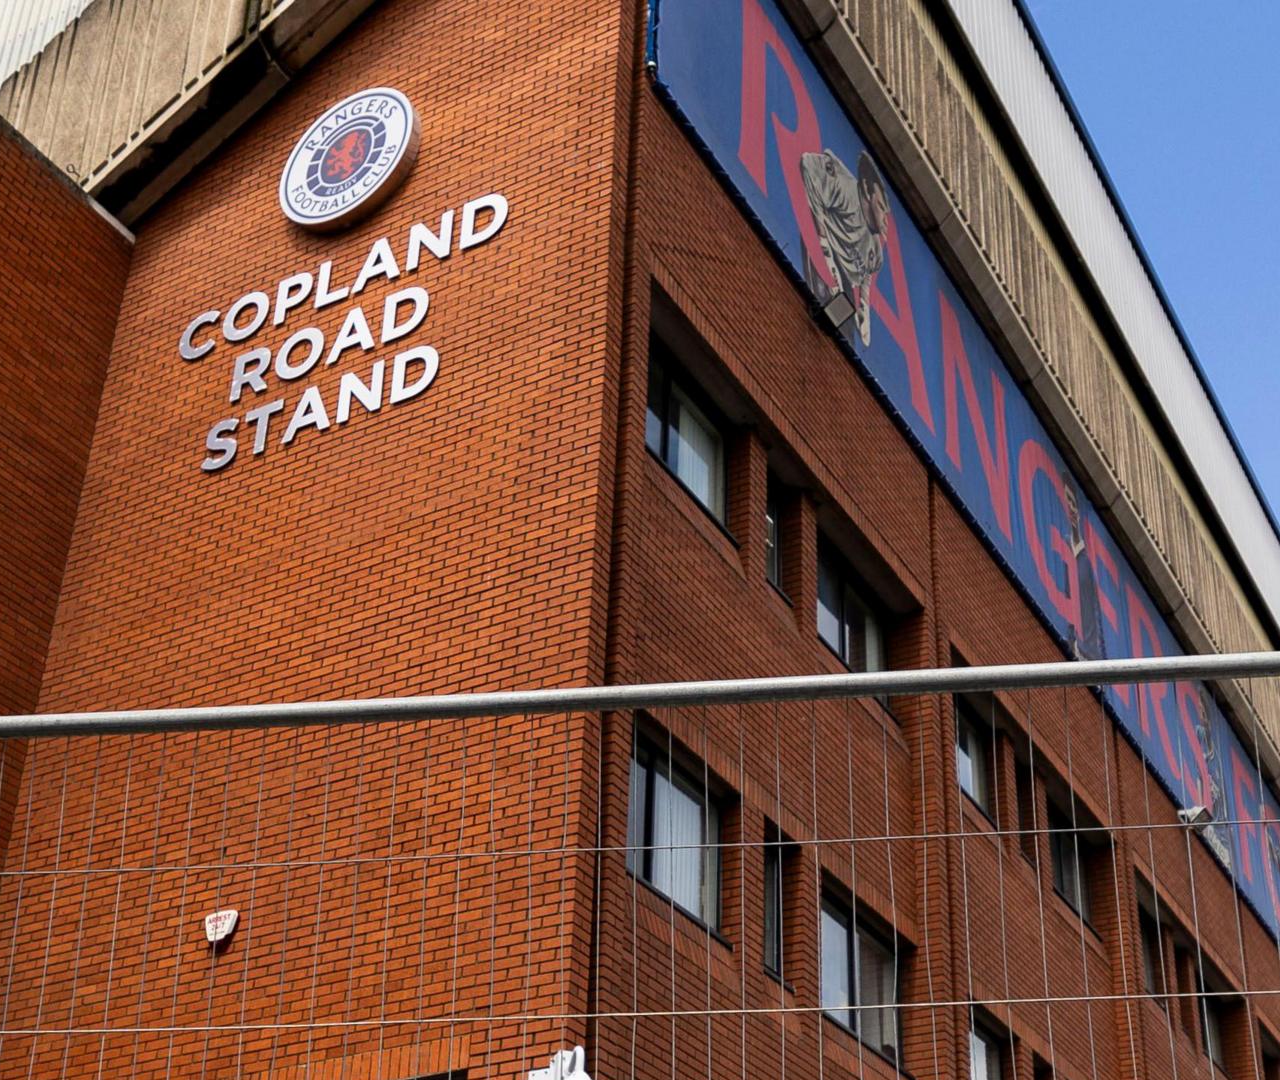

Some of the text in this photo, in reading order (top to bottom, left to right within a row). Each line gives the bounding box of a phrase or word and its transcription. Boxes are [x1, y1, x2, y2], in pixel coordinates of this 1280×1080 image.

[291, 143, 397, 214] FOOTBALL CLUB
[305, 98, 398, 152] RANGERS
[178, 193, 509, 361] COPLAND
[229, 286, 430, 402] ROAD
[200, 344, 440, 471] STAND
